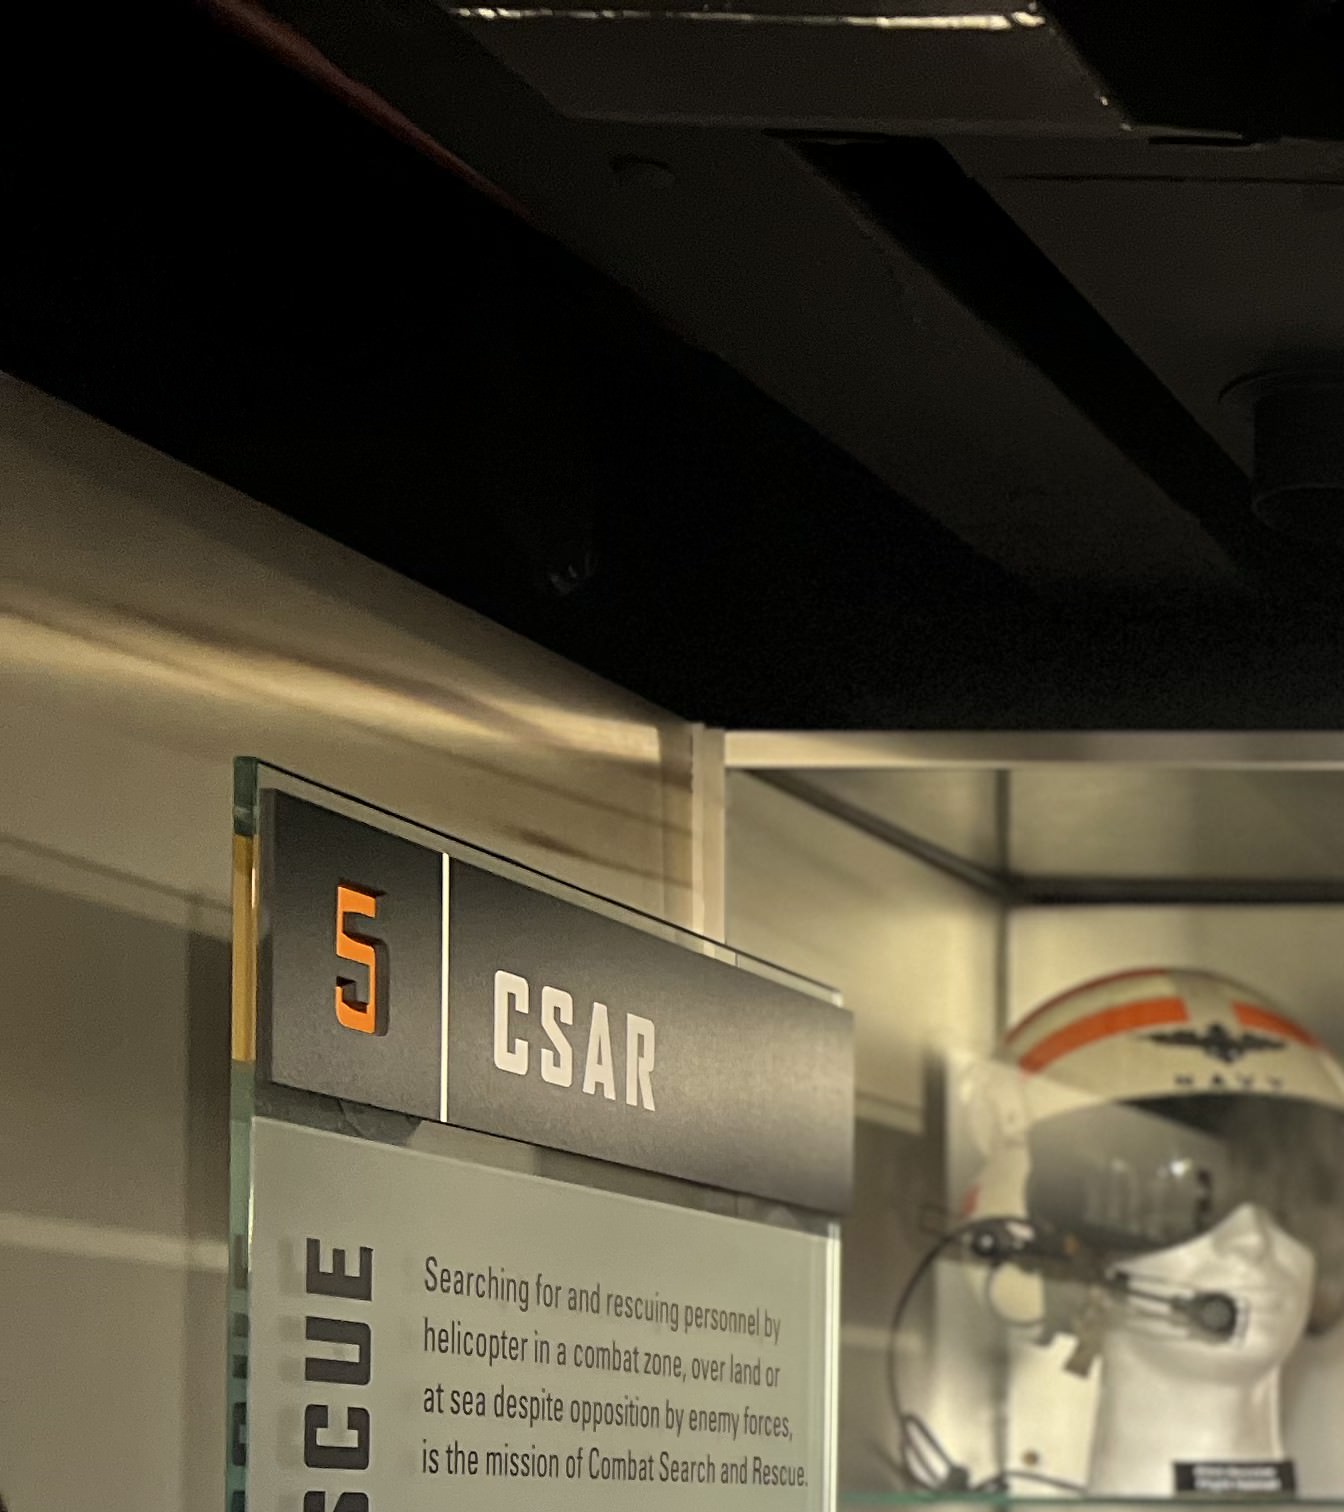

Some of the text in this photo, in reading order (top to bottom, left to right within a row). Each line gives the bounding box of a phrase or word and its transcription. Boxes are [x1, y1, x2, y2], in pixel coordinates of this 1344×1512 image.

[335, 882, 656, 1112] 5 CSAR
[424, 1255, 781, 1345] Searching for and rescuing personnel by
[423, 1316, 781, 1388] helicopter in a combat zone, over land or
[423, 1383, 793, 1441] at sea despite opposition by enemy forces,
[422, 1438, 809, 1487] is the mission of Combat Search and Rescue.
